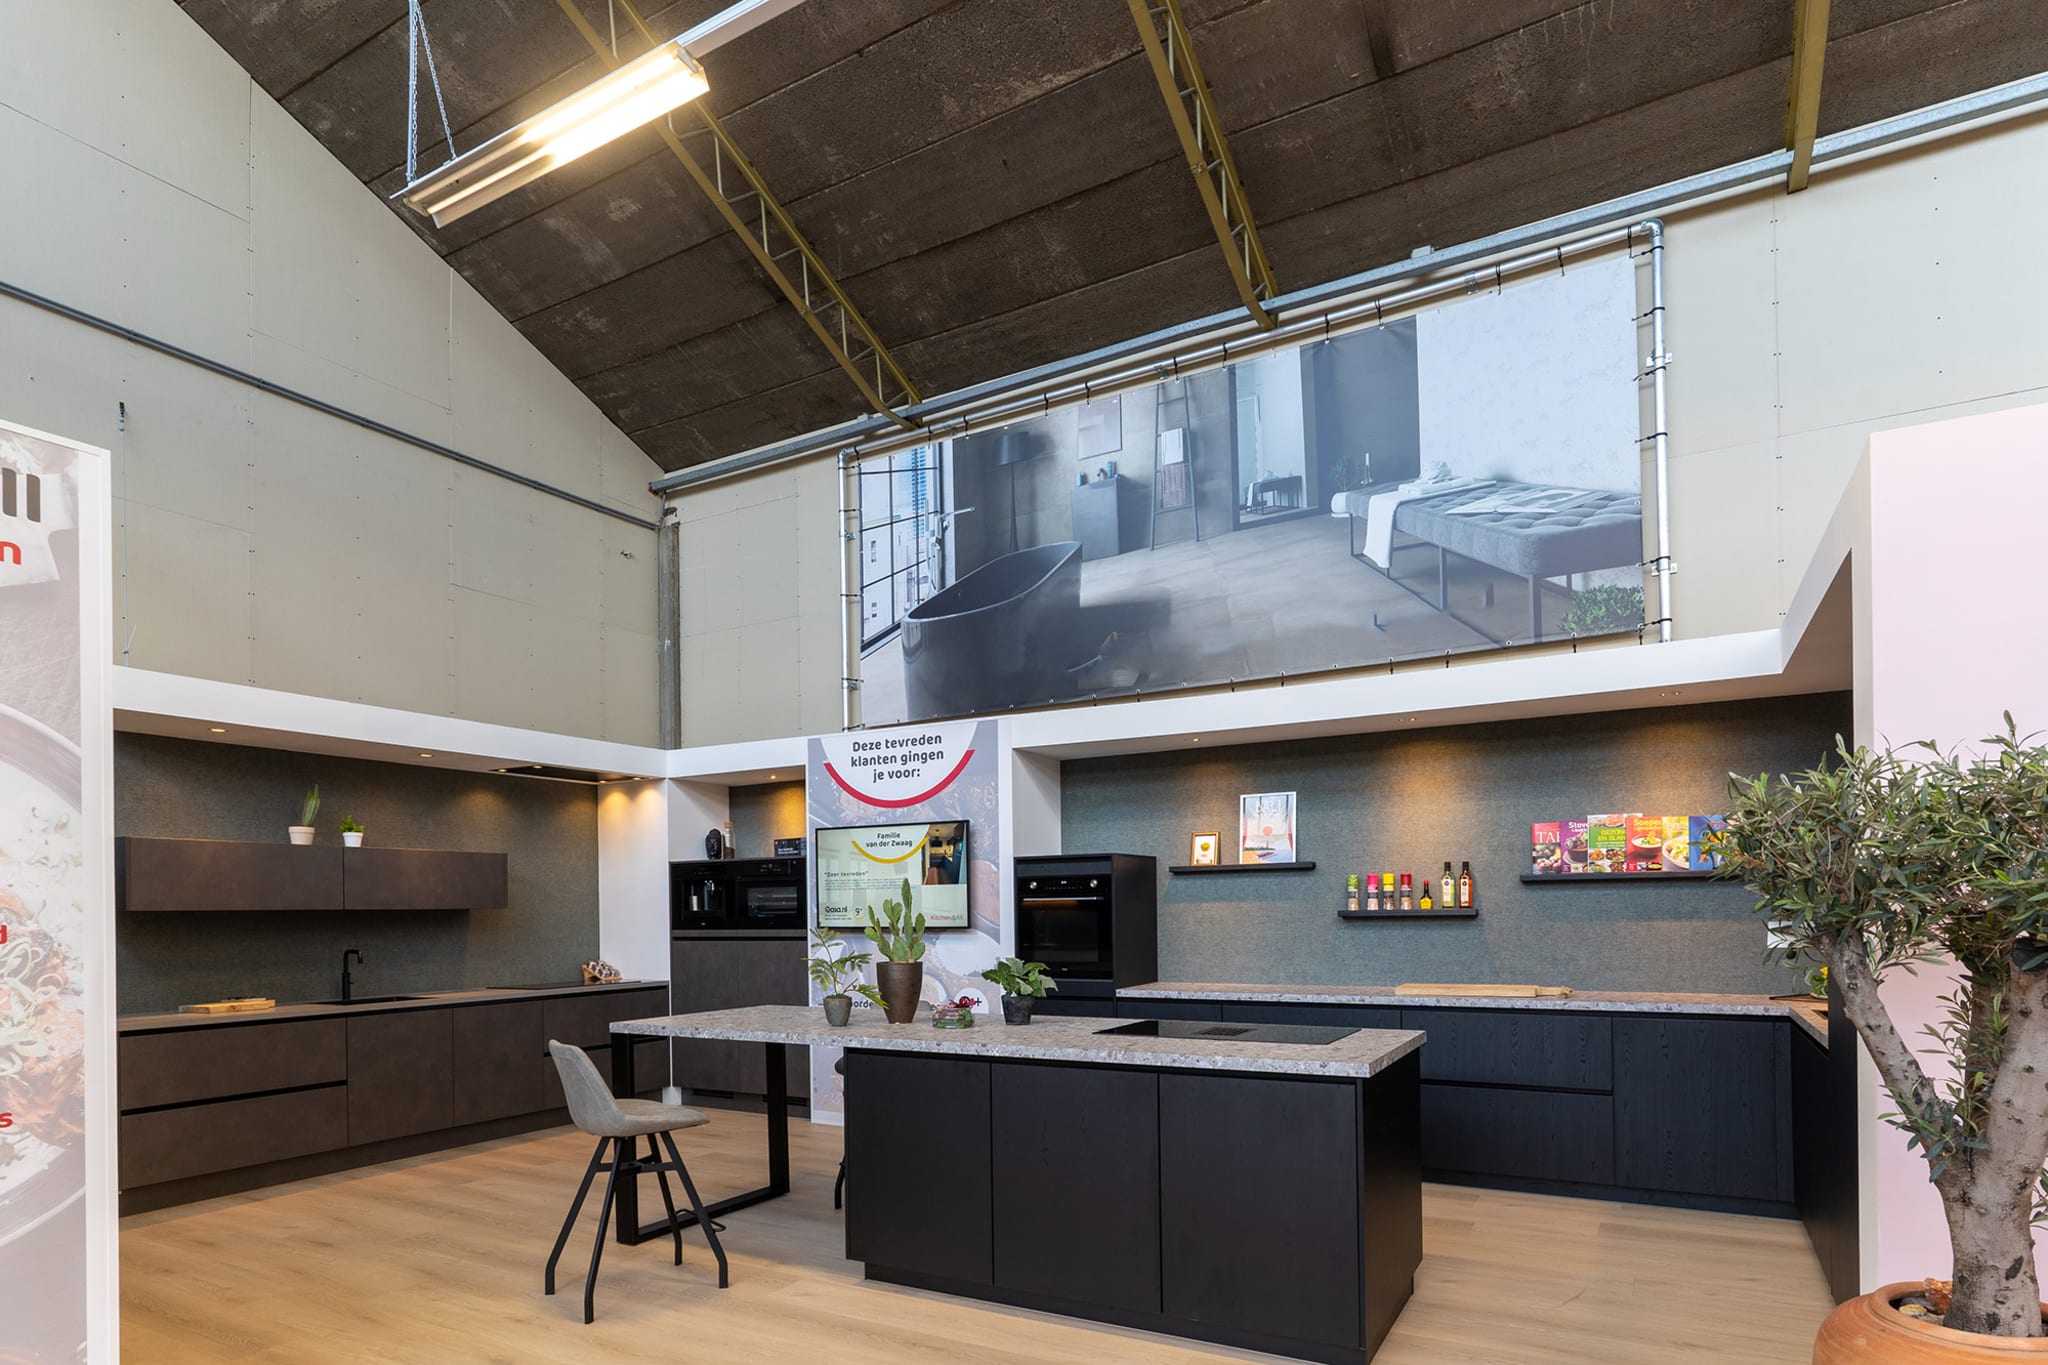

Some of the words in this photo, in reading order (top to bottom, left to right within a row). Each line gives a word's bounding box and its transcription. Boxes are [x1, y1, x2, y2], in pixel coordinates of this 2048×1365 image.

[853, 741, 882, 753] Deze
[885, 734, 942, 750] tevreden
[851, 754, 897, 768] klanten
[900, 750, 944, 766] gingen
[873, 769, 884, 784] je
[888, 768, 921, 780] voor:
[877, 831, 901, 840] Familie
[879, 840, 890, 848] der
[891, 839, 913, 848] Zwaag
